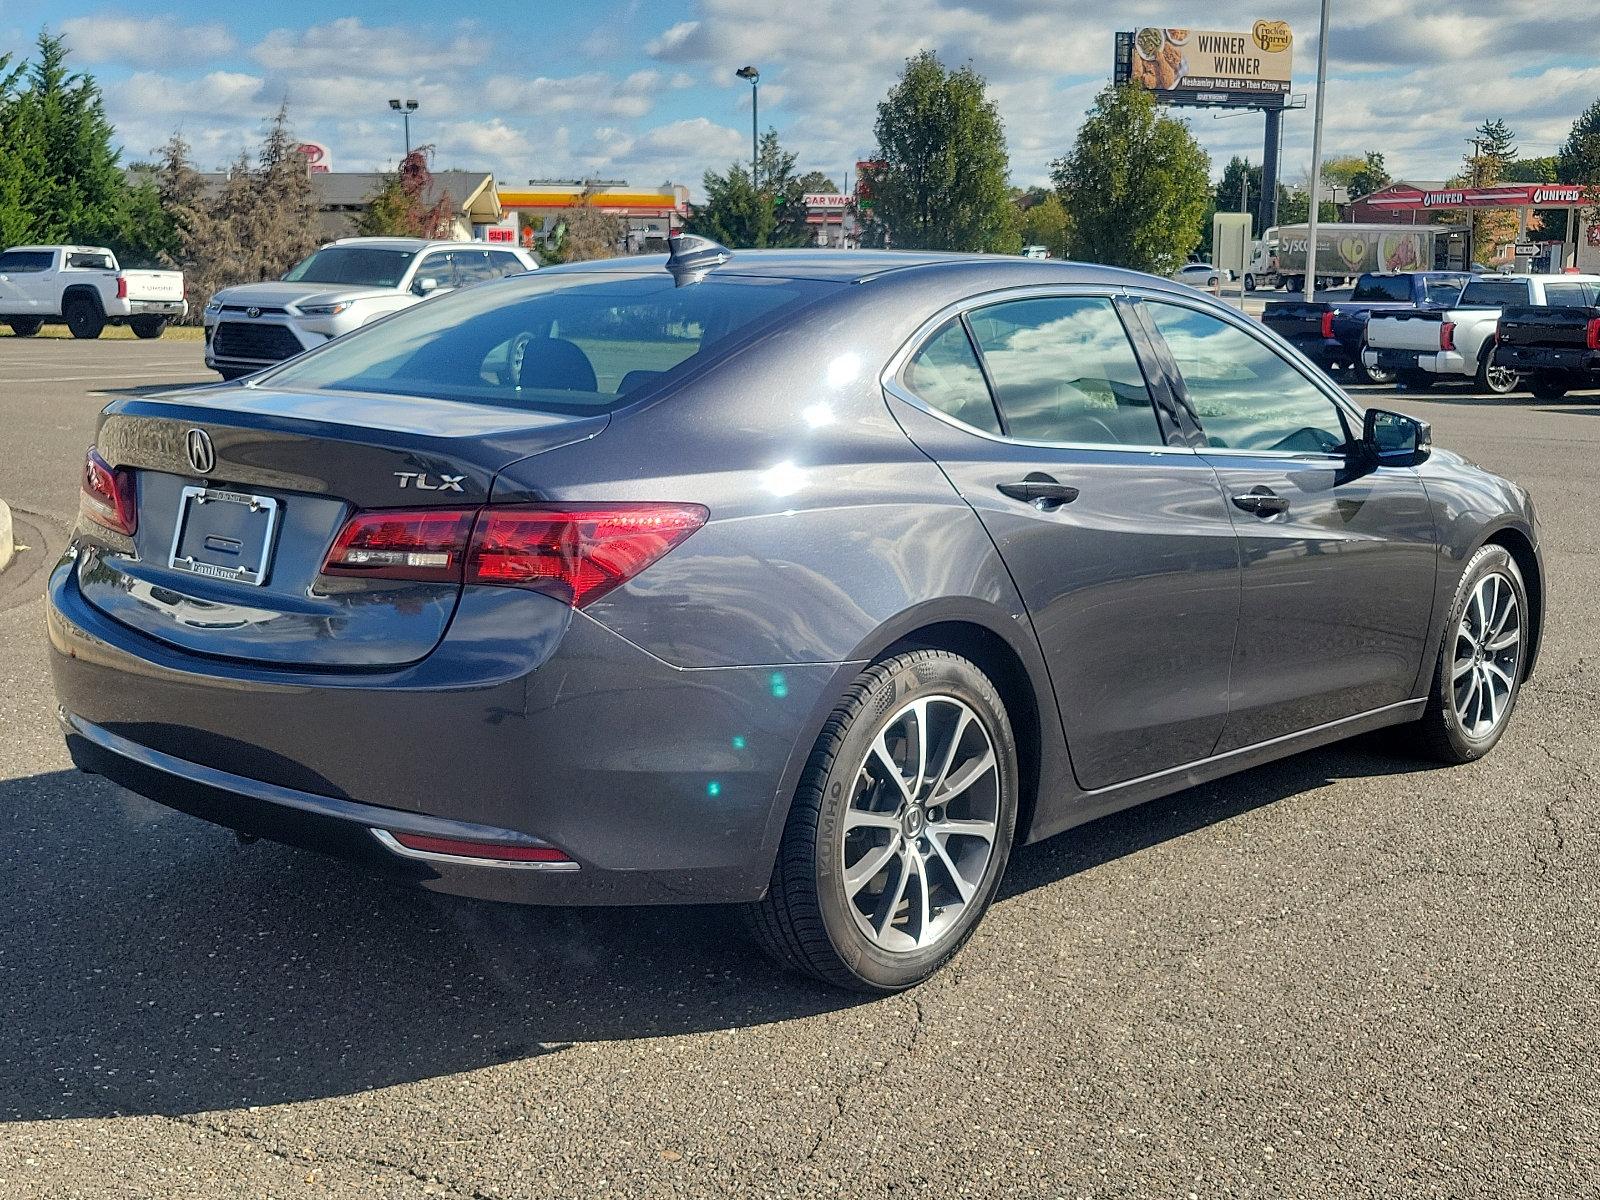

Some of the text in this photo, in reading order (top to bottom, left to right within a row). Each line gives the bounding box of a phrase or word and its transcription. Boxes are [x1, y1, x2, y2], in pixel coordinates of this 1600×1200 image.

[1255, 23, 1286, 40] Cracker
[1198, 35, 1245, 55] WINNER
[1260, 34, 1288, 51] Barrel
[1214, 56, 1260, 75] WINNER
[1215, 79, 1228, 88] Mall
[1229, 80, 1241, 88] Exit
[1261, 81, 1279, 92] Crispy
[805, 196, 825, 205] CAR
[1431, 193, 1463, 204] UNITED
[1542, 190, 1579, 201] UNITED
[393, 471, 468, 492] TLX
[192, 561, 240, 579] Faulkner
[816, 780, 842, 877] KUMHO
